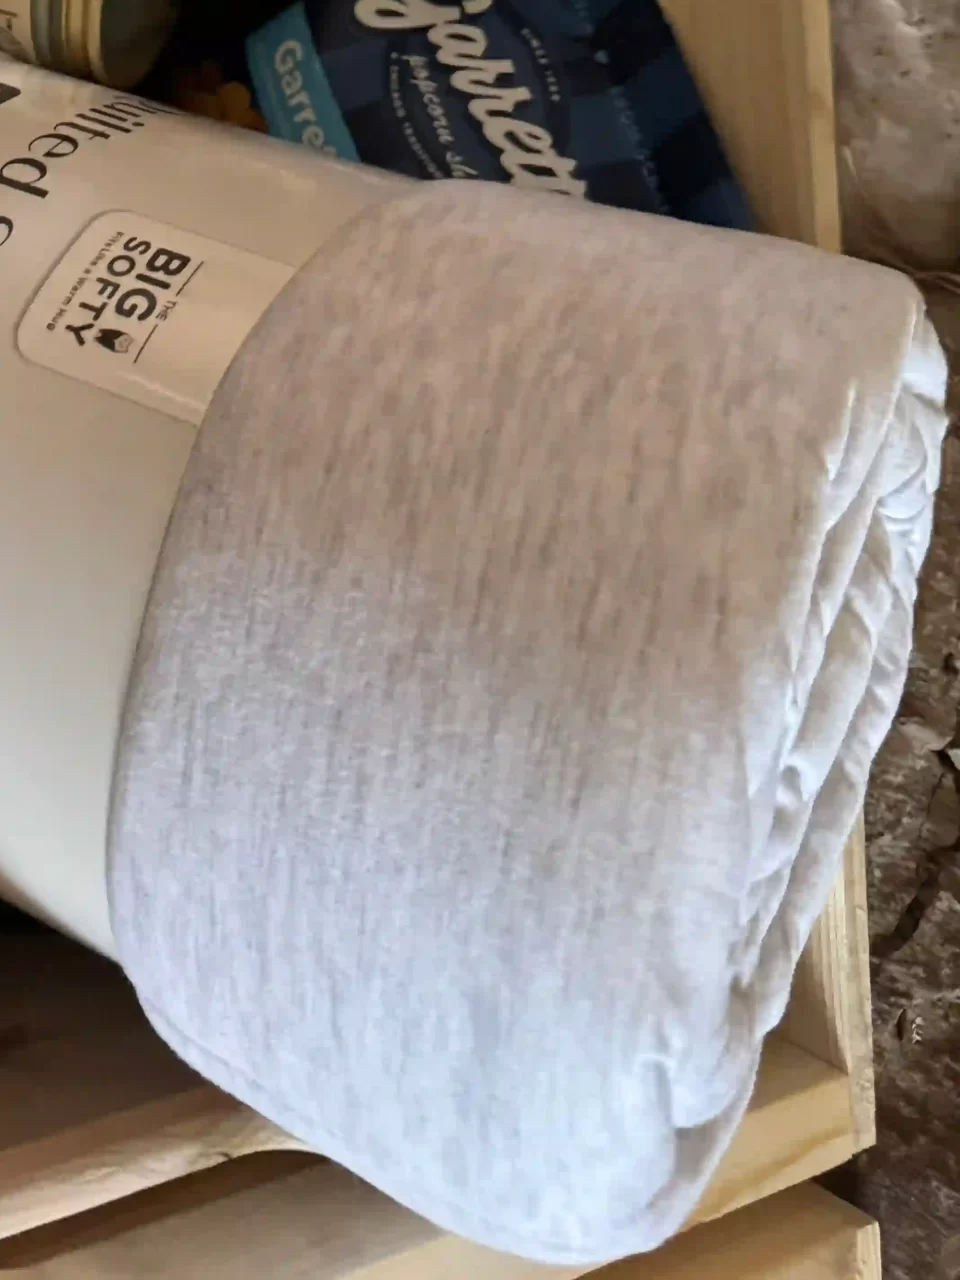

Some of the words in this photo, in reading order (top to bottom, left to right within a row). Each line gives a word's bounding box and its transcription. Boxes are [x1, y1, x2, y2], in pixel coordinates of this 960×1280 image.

[400, 54, 455, 145] popcorn
[65, 236, 152, 347] SOFTY
[114, 247, 192, 322] BIG
[155, 299, 178, 322] THE
